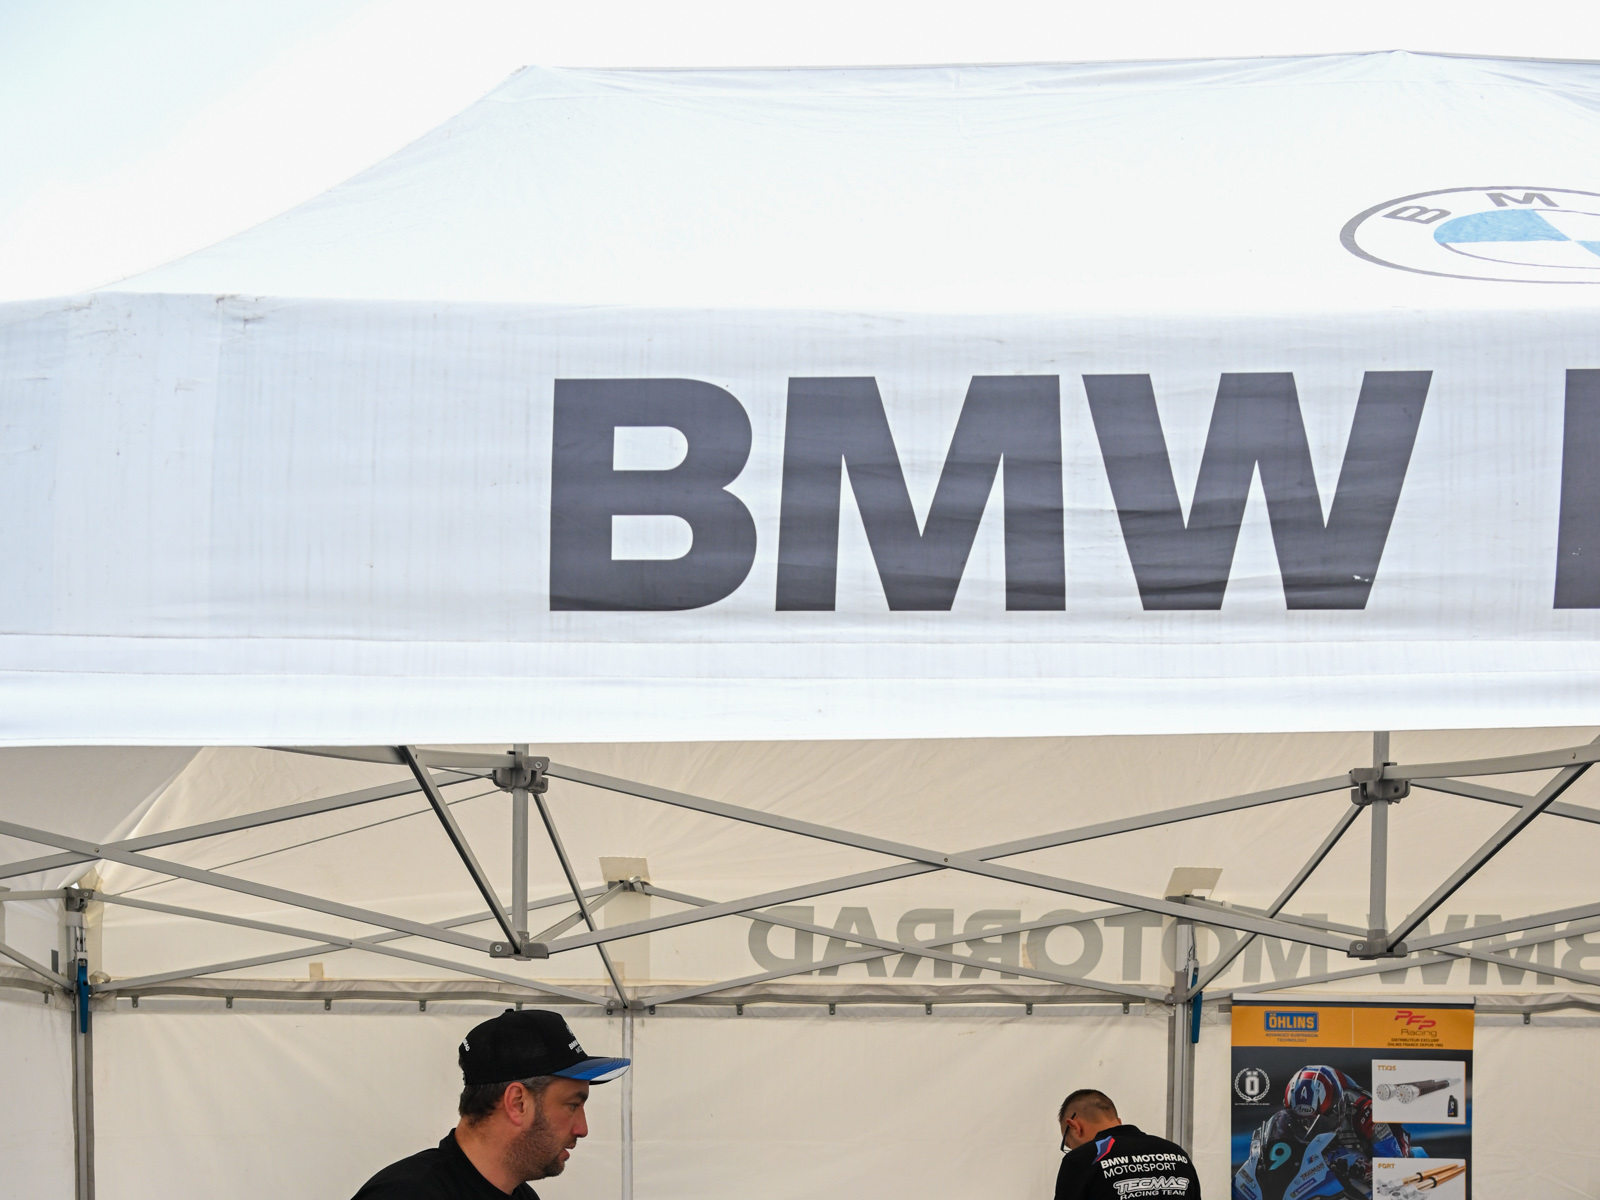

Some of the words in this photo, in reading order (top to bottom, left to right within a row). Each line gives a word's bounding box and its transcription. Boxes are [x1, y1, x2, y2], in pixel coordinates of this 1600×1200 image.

[549, 370, 1433, 612] BMW
[1269, 1013, 1315, 1029] ÖHLINS
[1394, 1010, 1437, 1030] PFP
[1400, 1029, 1438, 1037] Racing
[1100, 1155, 1129, 1169] BMW
[1131, 1153, 1189, 1165] MOTORRAD
[1103, 1162, 1176, 1179] MOTORSPORT
[1113, 1175, 1190, 1195] TECMAS
[1120, 1189, 1160, 1200] RACING
[1162, 1189, 1186, 1197] TEAM
